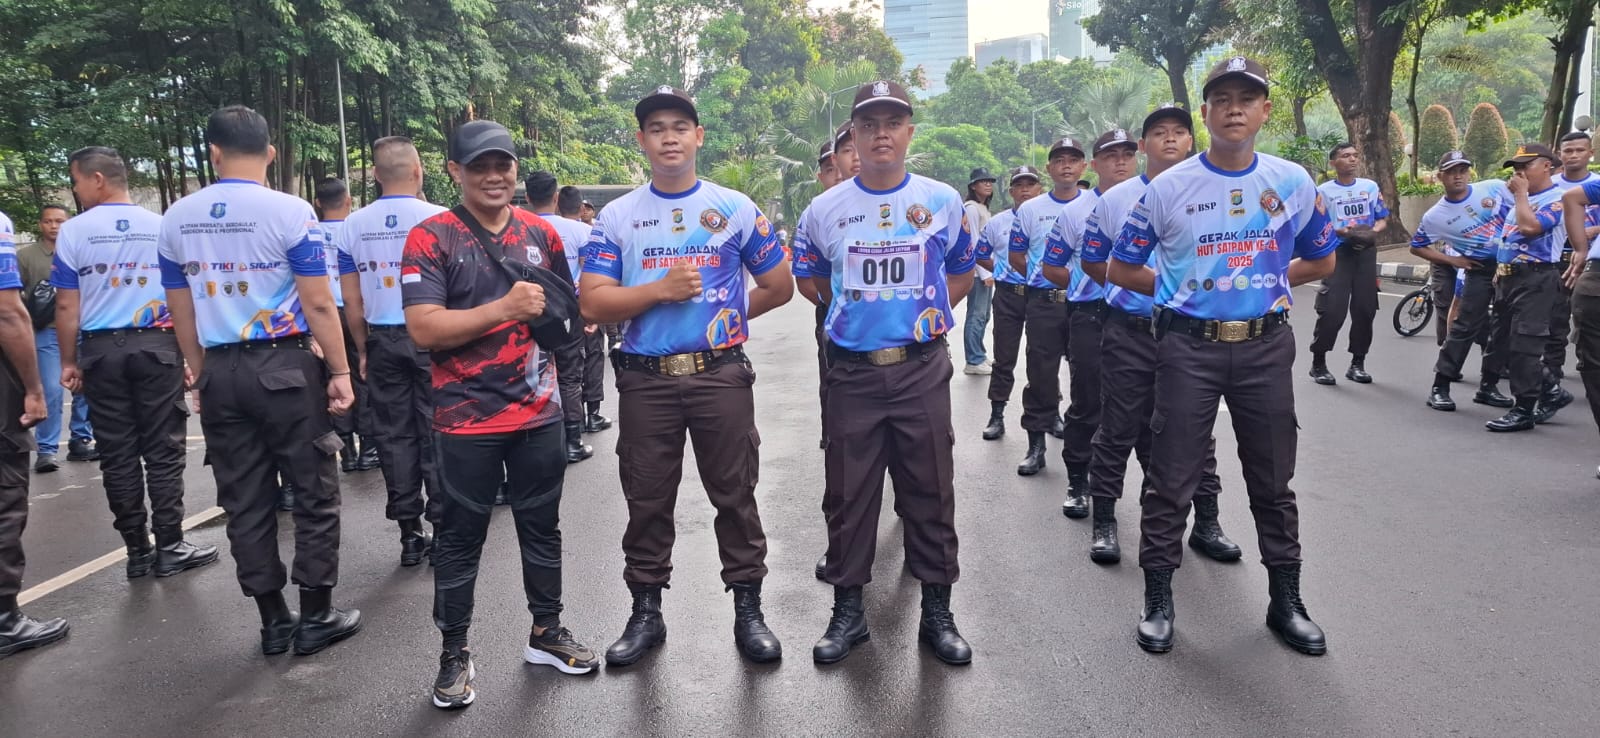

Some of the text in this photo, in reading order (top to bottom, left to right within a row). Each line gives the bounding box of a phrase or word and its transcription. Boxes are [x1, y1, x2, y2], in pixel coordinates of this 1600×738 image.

[1197, 202, 1217, 212] BSP
[1343, 203, 1364, 216] 008
[642, 219, 660, 228] BSP
[1199, 231, 1238, 243] GERAK
[642, 245, 719, 257] GERAK JALAN
[1197, 244, 1214, 256] HUT
[1216, 240, 1254, 253] SATPAM
[210, 262, 236, 271] TIKI
[249, 261, 281, 270] SIGAP
[641, 258, 657, 270] HUT
[695, 255, 720, 269] KE-45
[1227, 255, 1253, 268] 2025
[862, 257, 905, 285] 010
